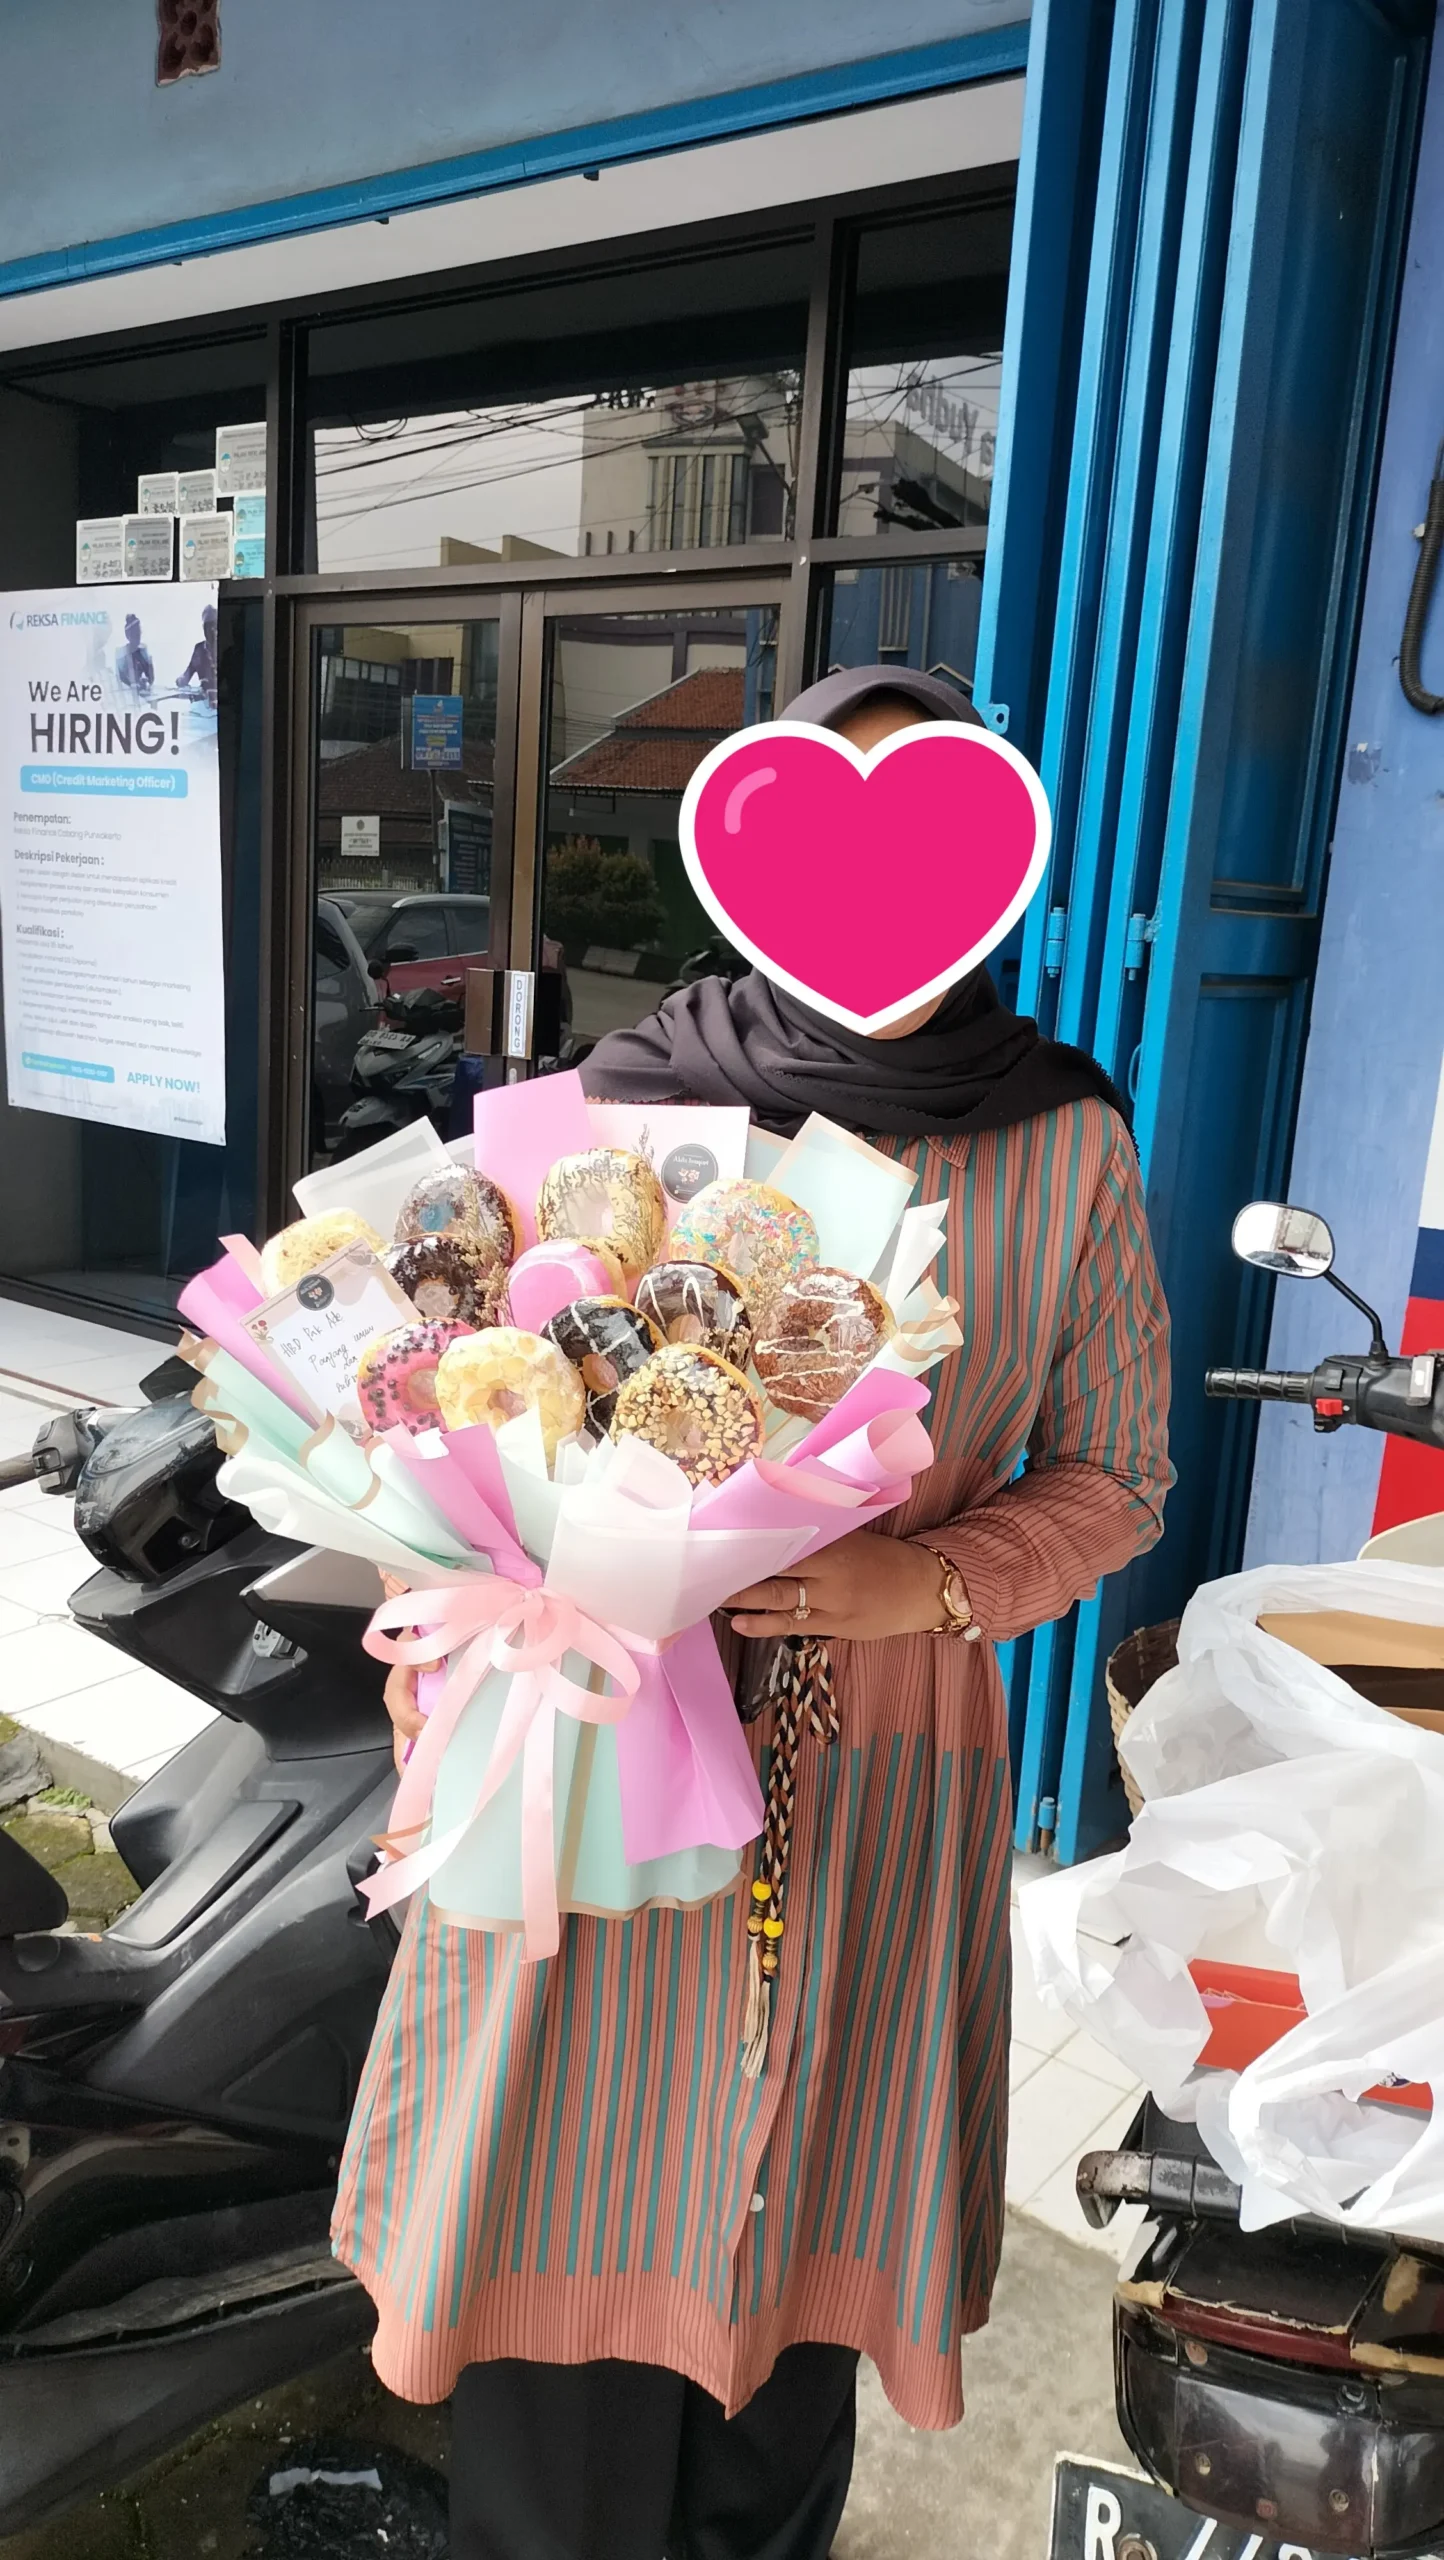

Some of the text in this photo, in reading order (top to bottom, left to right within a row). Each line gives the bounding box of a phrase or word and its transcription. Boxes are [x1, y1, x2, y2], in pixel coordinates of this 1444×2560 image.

[27, 611, 109, 627] REKSA FINANCE
[28, 680, 102, 702] We Are
[30, 711, 180, 756] HIRING!
[31, 771, 176, 792] CMO (Credit Marketing Officer)
[13, 811, 72, 826] Penempatan:
[15, 849, 54, 864] Deskripsi
[16, 924, 60, 938] Kualifikasi
[514, 978, 524, 1049] DORONG
[127, 1071, 163, 1088] APPLY
[164, 1076, 201, 1094] NOW!
[281, 1339, 302, 1358] HBD
[308, 1344, 348, 1373] Panjang
[1084, 2486, 1123, 2560] R
